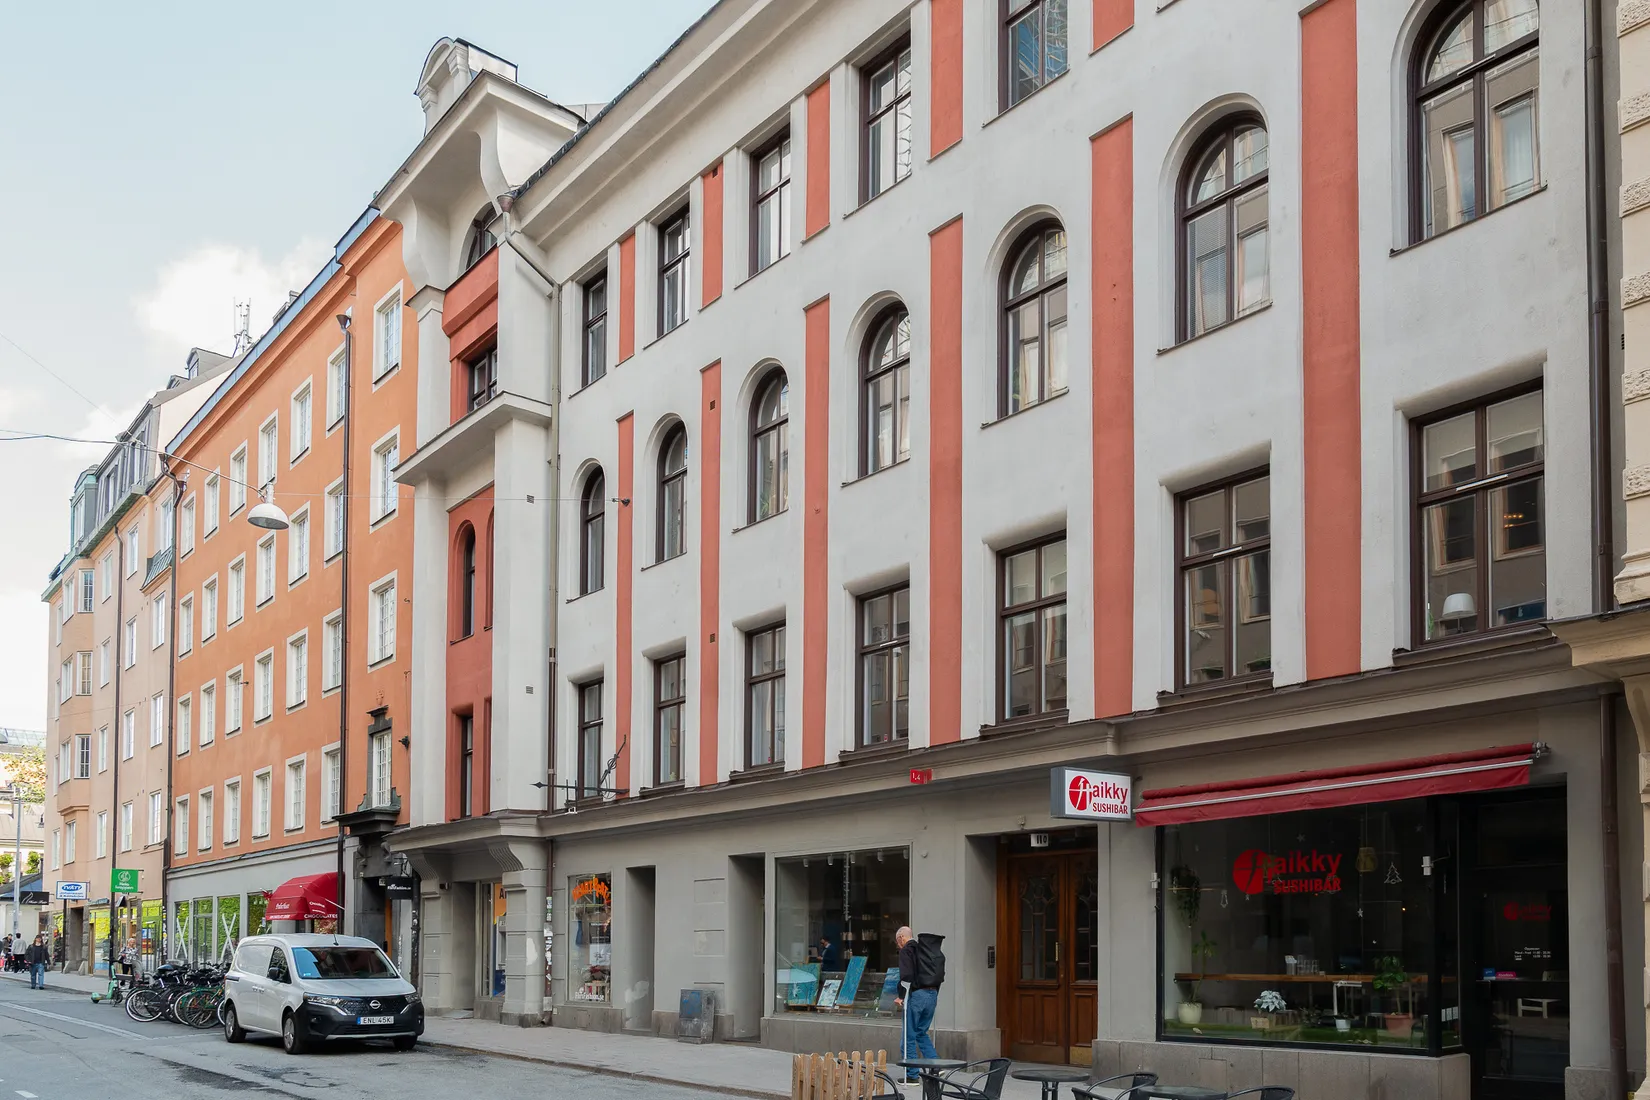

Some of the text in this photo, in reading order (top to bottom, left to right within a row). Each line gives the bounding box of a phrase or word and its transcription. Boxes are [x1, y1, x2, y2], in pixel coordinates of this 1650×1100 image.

[1092, 802, 1129, 815] SUSHIBAR
[1036, 835, 1047, 844] 110
[1273, 877, 1342, 894] SUSHIBAR
